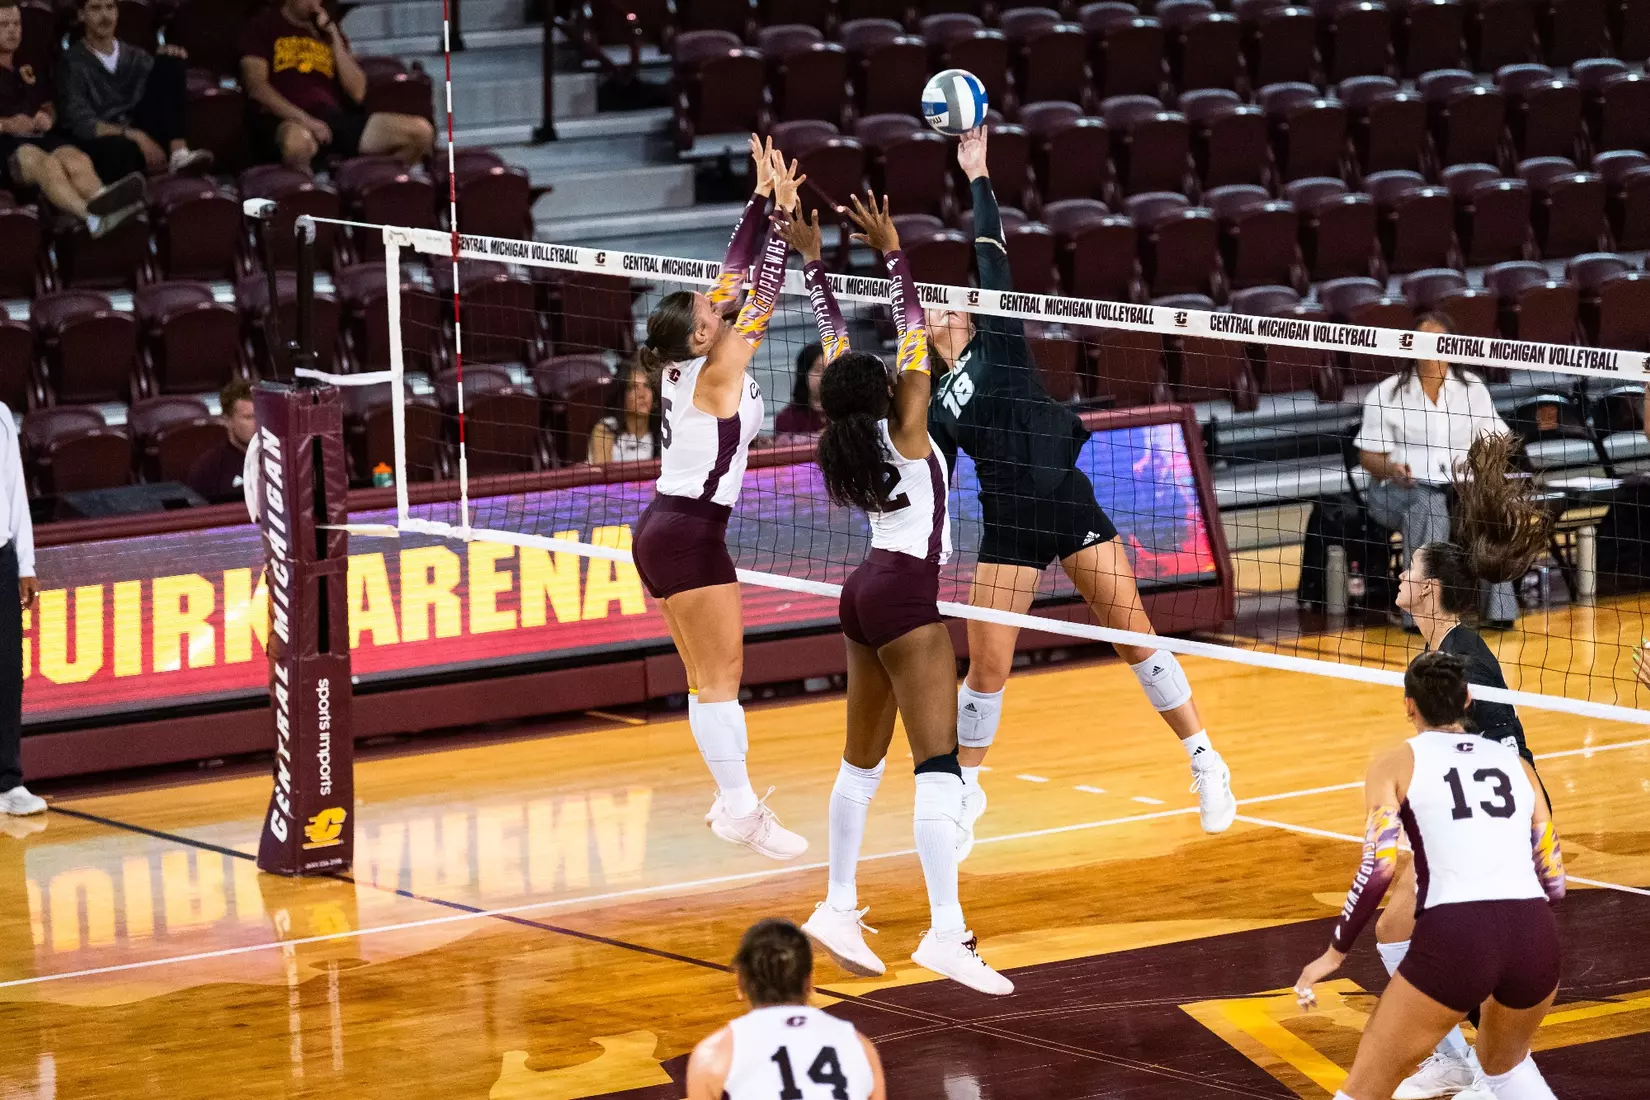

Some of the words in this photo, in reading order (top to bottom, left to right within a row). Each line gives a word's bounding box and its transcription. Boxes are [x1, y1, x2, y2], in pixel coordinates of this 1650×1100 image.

[457, 236, 488, 253] ENTRAL
[490, 240, 529, 259] MICHIGAN
[531, 246, 579, 265] VOLLEYBALL
[623, 254, 659, 273] CENTRAL
[661, 259, 703, 278] MICHIGAN
[753, 238, 787, 313] CHIPPEWAS
[846, 277, 890, 298] MICHIGAN
[917, 284, 949, 304] YBALL
[1000, 293, 1041, 314] CENTRAL
[1044, 299, 1092, 319] MICHIGAN
[1095, 305, 1154, 325] VOLLEYBALL
[1210, 314, 1255, 335] CENTRAL
[1257, 319, 1310, 342] MICHIGAN
[1313, 325, 1378, 348] VOLLEYBALL
[1436, 336, 1485, 358] CENTRAL
[1489, 341, 1545, 364] MICHIGAN
[1549, 347, 1619, 371] VOLLEYBALL
[942, 371, 975, 420] 18
[261, 426, 290, 644] MICHIGAN
[347, 524, 647, 649] ARENA
[316, 678, 332, 731] sports
[270, 663, 292, 843] CENTRAL
[316, 732, 333, 796] imports
[1443, 767, 1517, 820] 13
[771, 1045, 849, 1100] 14
